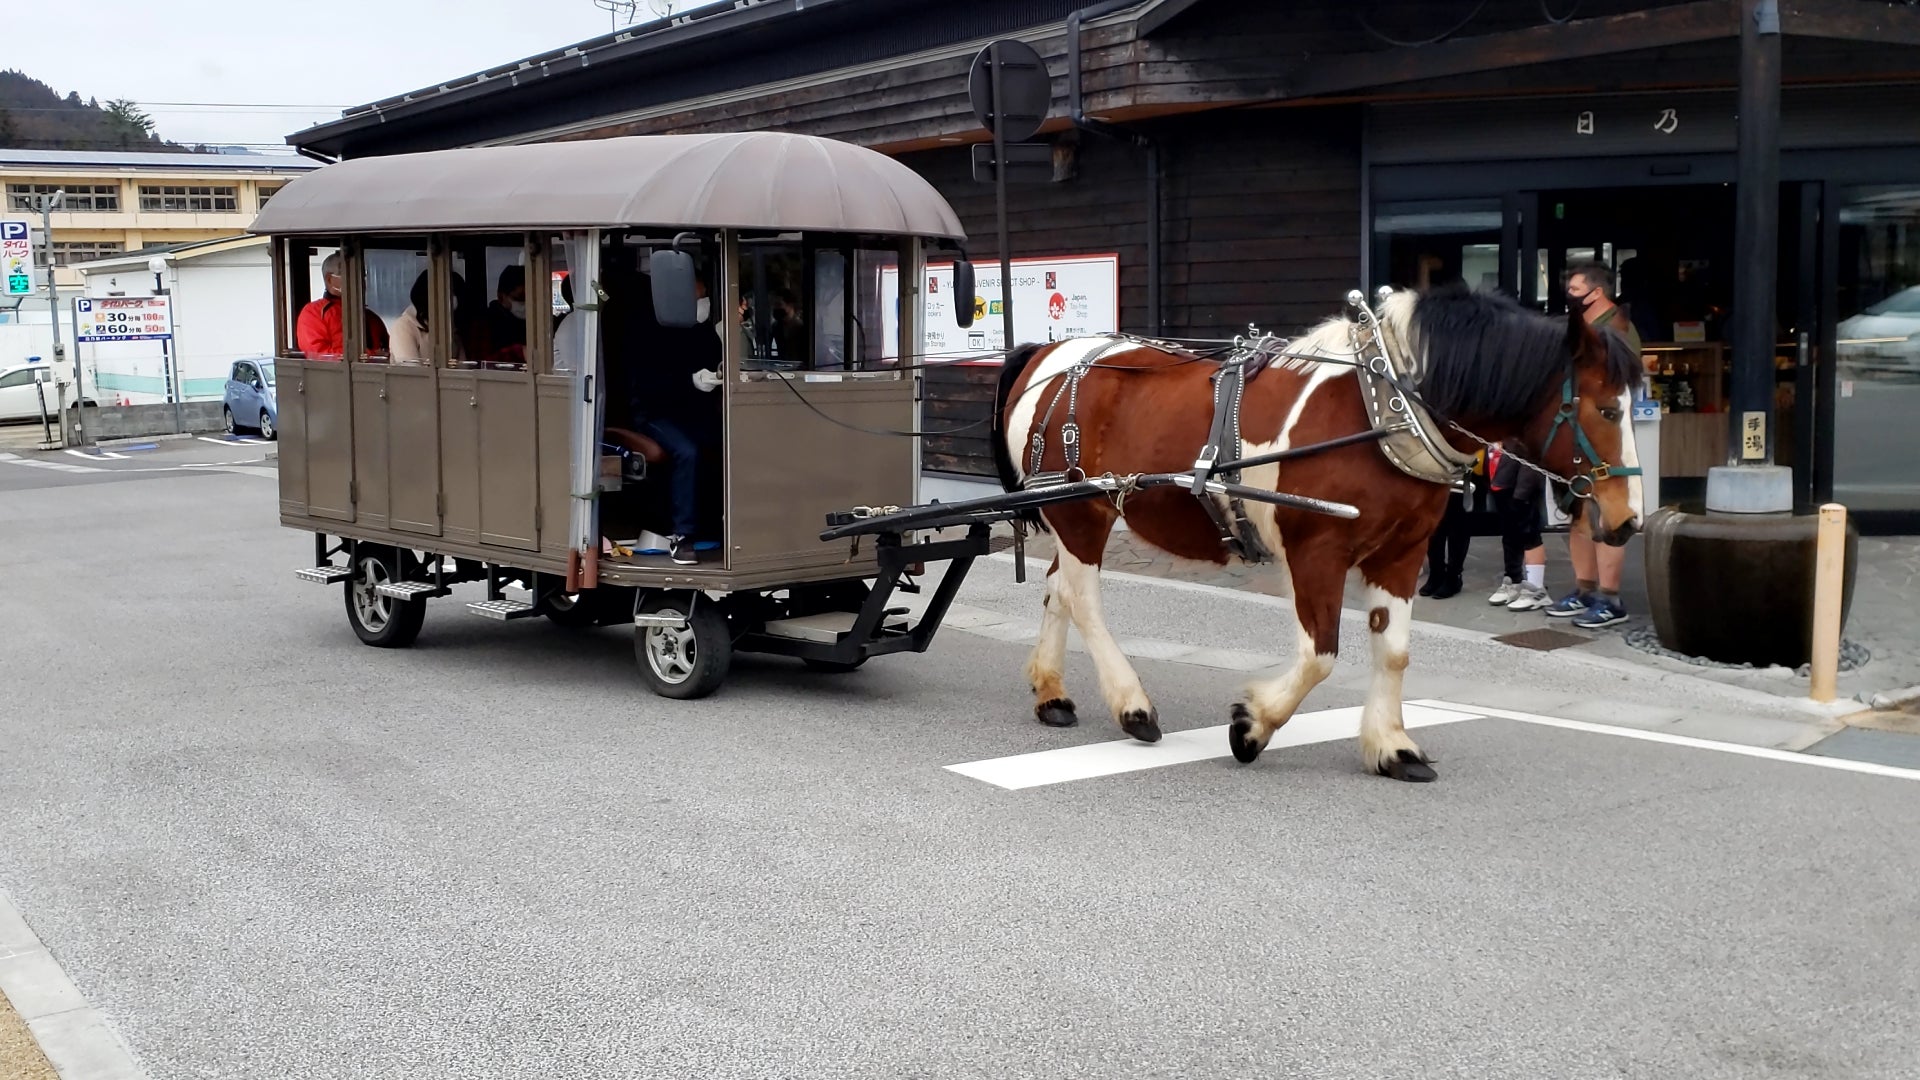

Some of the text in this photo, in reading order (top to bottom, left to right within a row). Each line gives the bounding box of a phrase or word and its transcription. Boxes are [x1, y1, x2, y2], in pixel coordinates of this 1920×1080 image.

[4, 223, 25, 239] P
[976, 279, 996, 288] UVENIR
[1019, 277, 1035, 287] SHOP
[81, 300, 91, 311] P
[972, 338, 981, 347] OK
